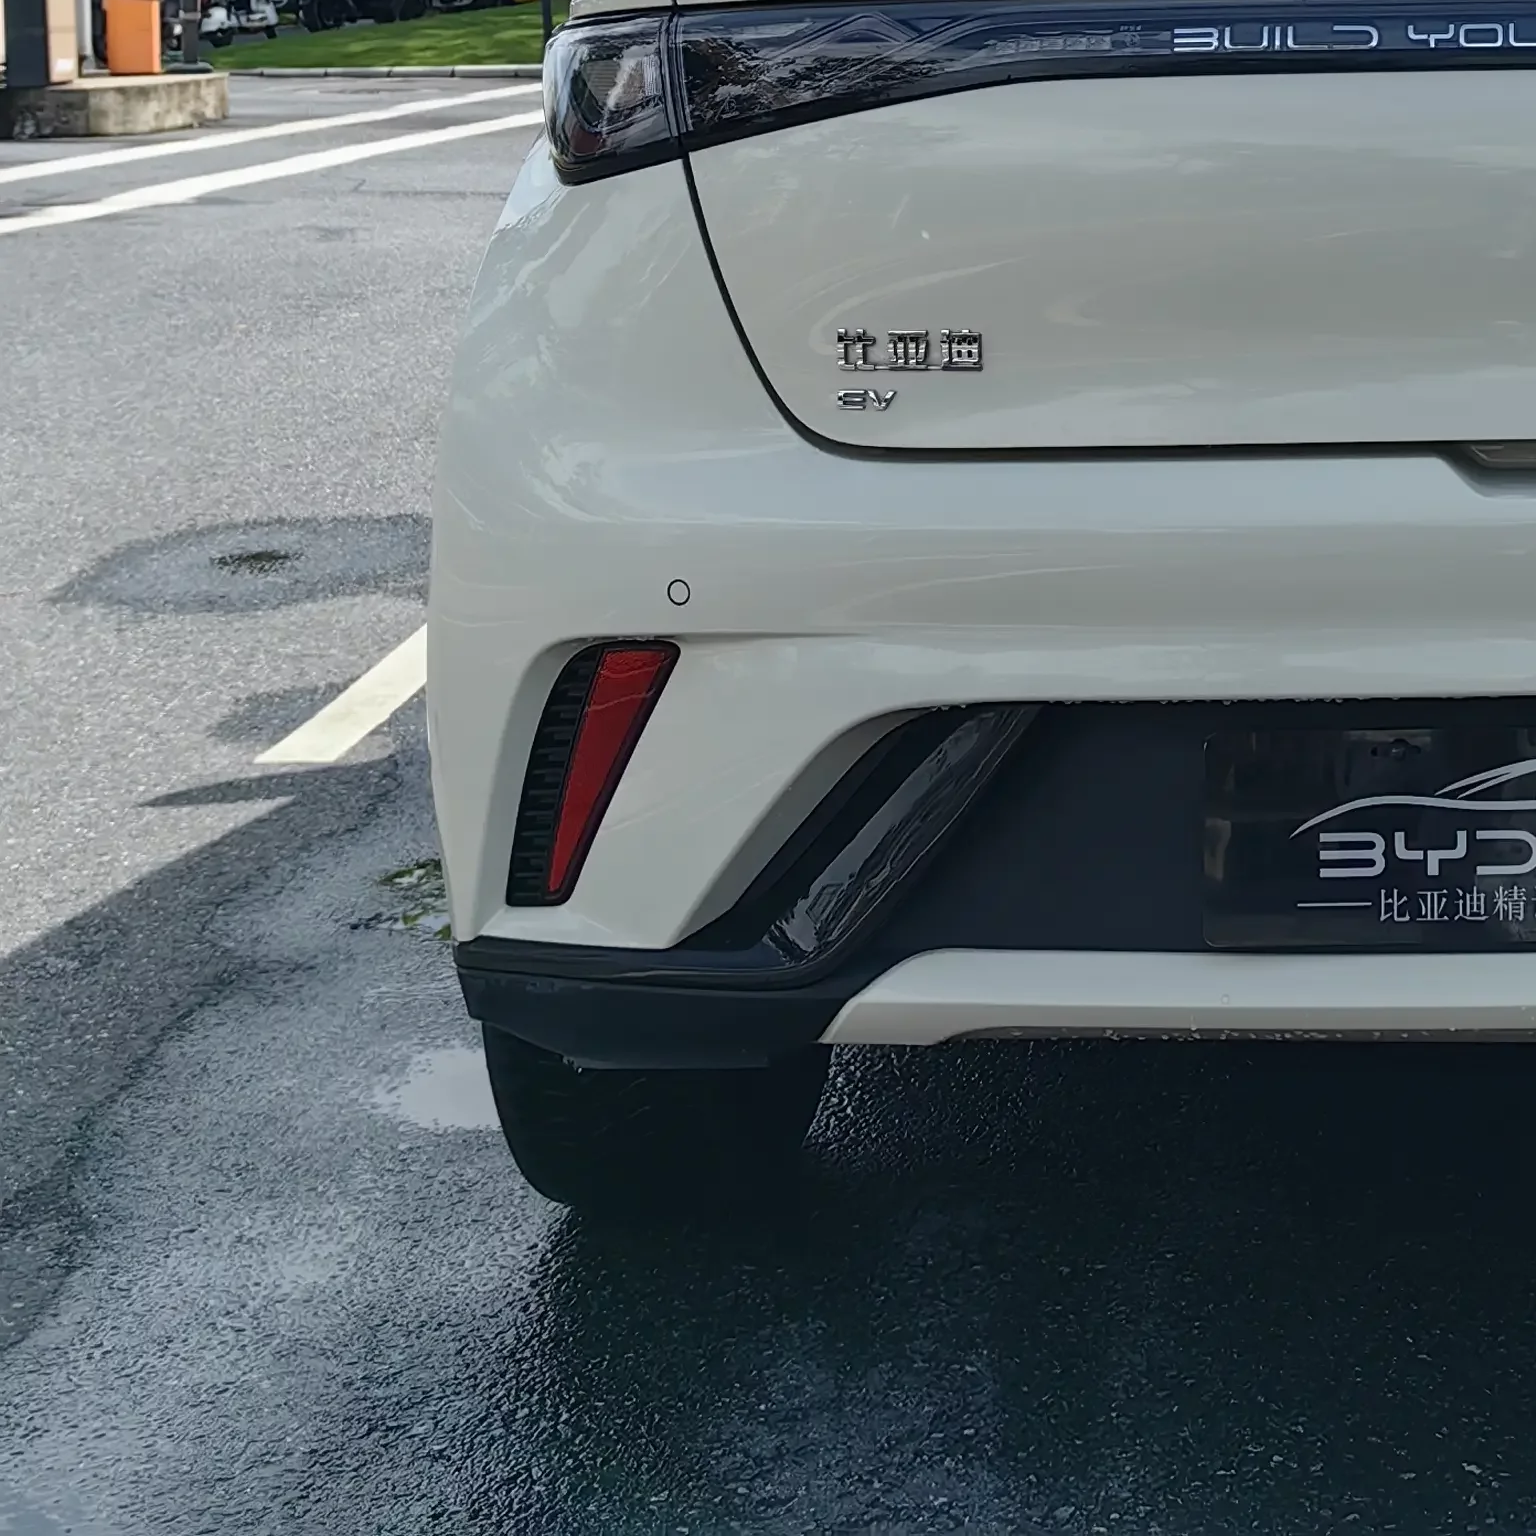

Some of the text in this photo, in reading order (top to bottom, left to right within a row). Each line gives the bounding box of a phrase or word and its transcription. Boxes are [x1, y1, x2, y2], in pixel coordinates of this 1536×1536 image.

[1173, 23, 1379, 52] BUILD
[837, 329, 983, 372] 比亚迪
[837, 388, 898, 412] EV
